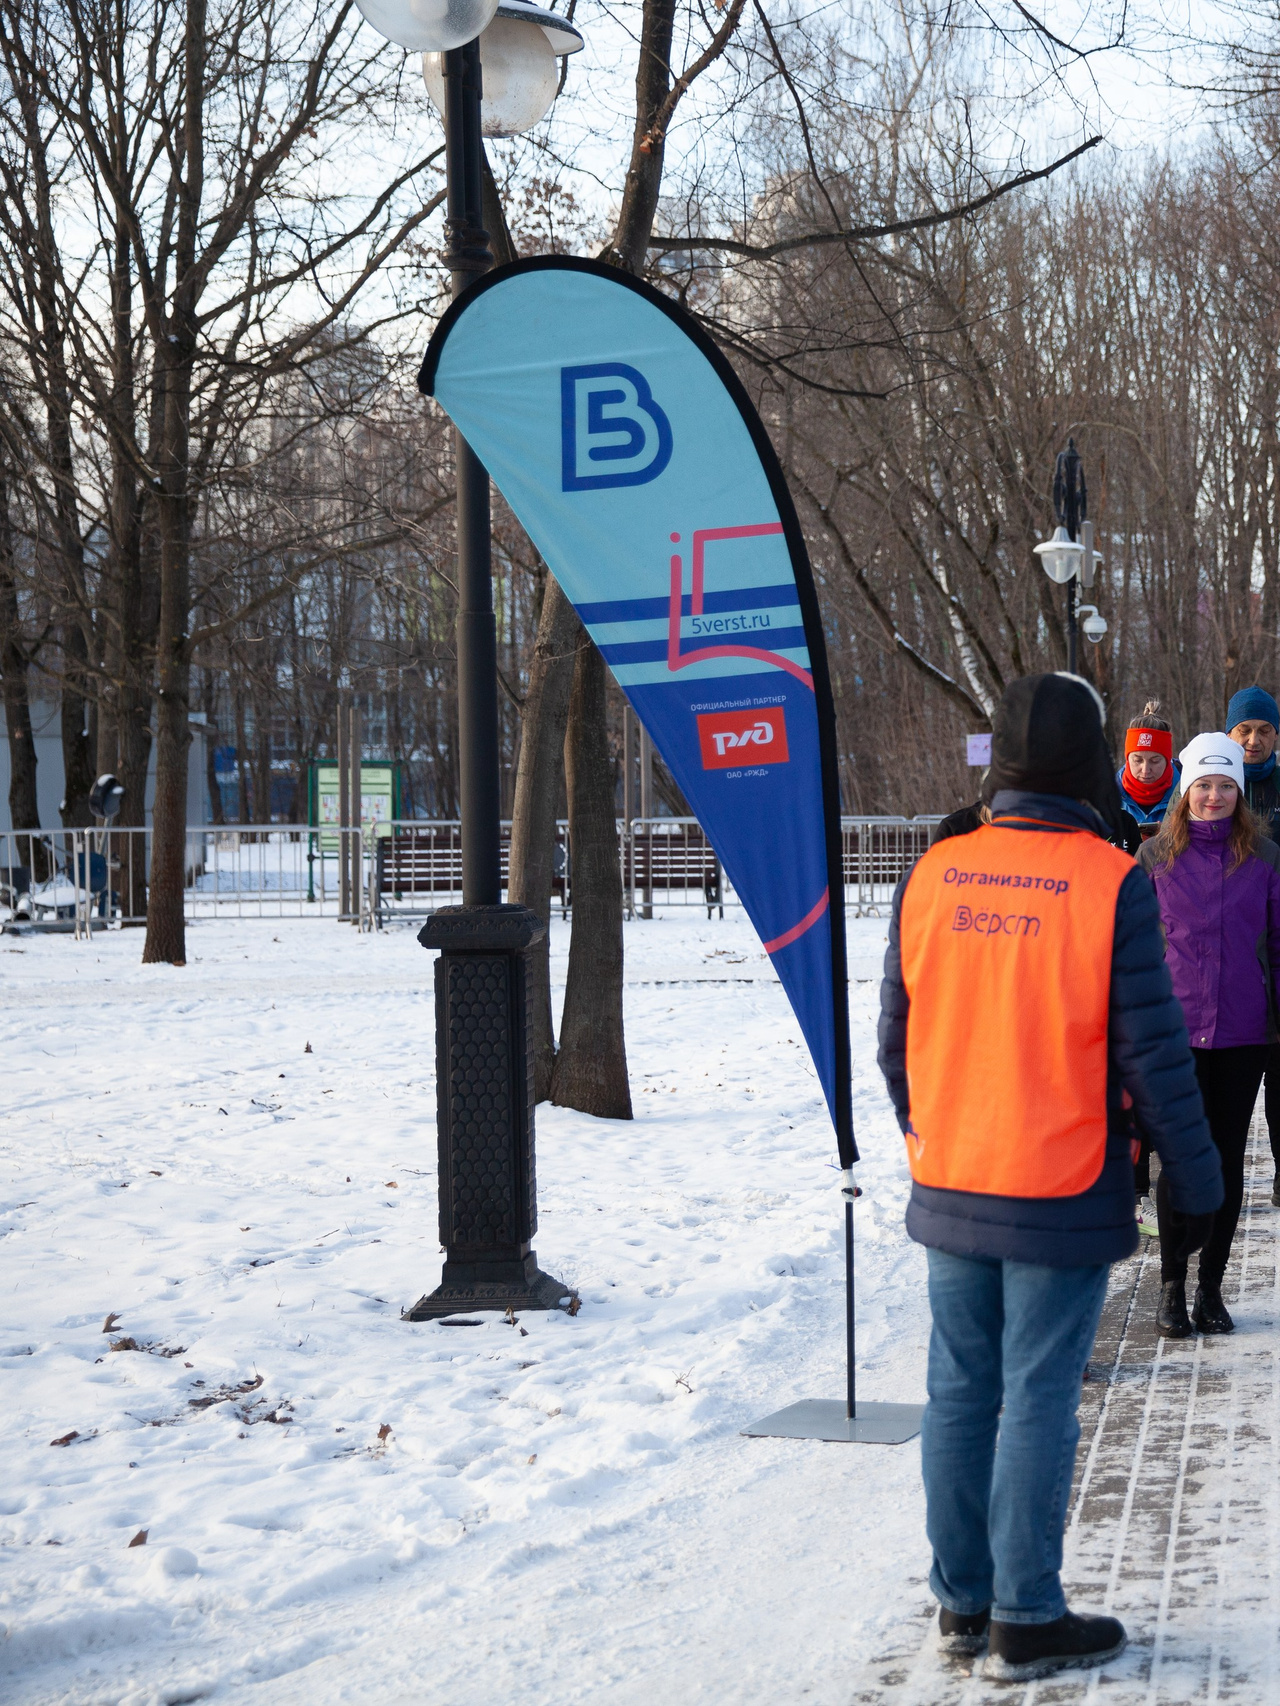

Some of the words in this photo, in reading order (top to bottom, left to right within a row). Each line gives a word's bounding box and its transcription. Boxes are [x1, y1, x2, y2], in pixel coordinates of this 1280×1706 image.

[691, 613, 771, 635] 5verst.ru
[690, 697, 752, 711] ОФИЦИАЛЬНЫЙ
[753, 695, 787, 705] ПАРТНЕР
[726, 771, 742, 779] ОАО
[744, 768, 769, 777] «РЖД»
[943, 867, 1069, 896] Организатор
